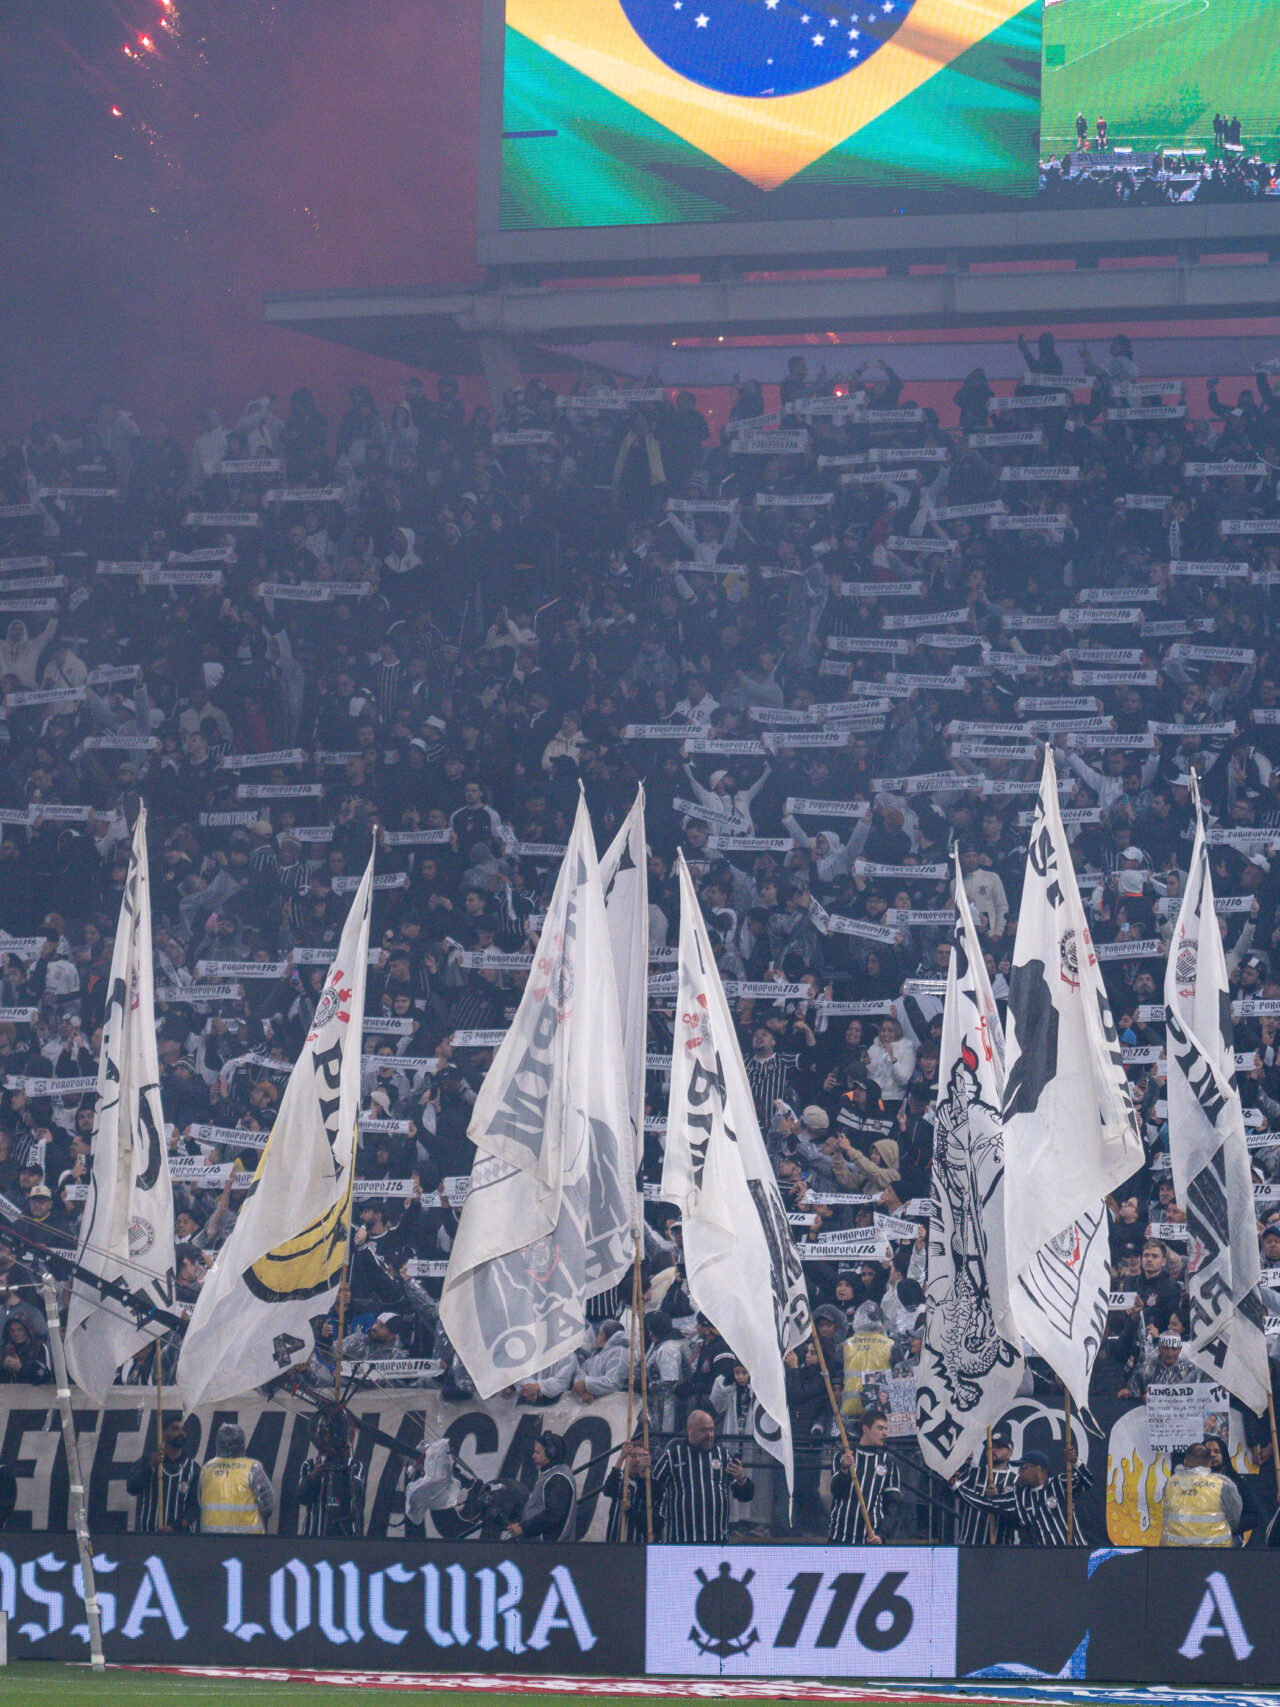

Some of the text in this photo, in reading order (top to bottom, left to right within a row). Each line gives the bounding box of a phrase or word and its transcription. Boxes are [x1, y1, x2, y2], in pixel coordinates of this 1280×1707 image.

[1148, 1386, 1194, 1396] LINGARD
[221, 1557, 598, 1655] LOUCURA
[773, 1571, 914, 1652] 116
[1178, 1571, 1255, 1661] A
